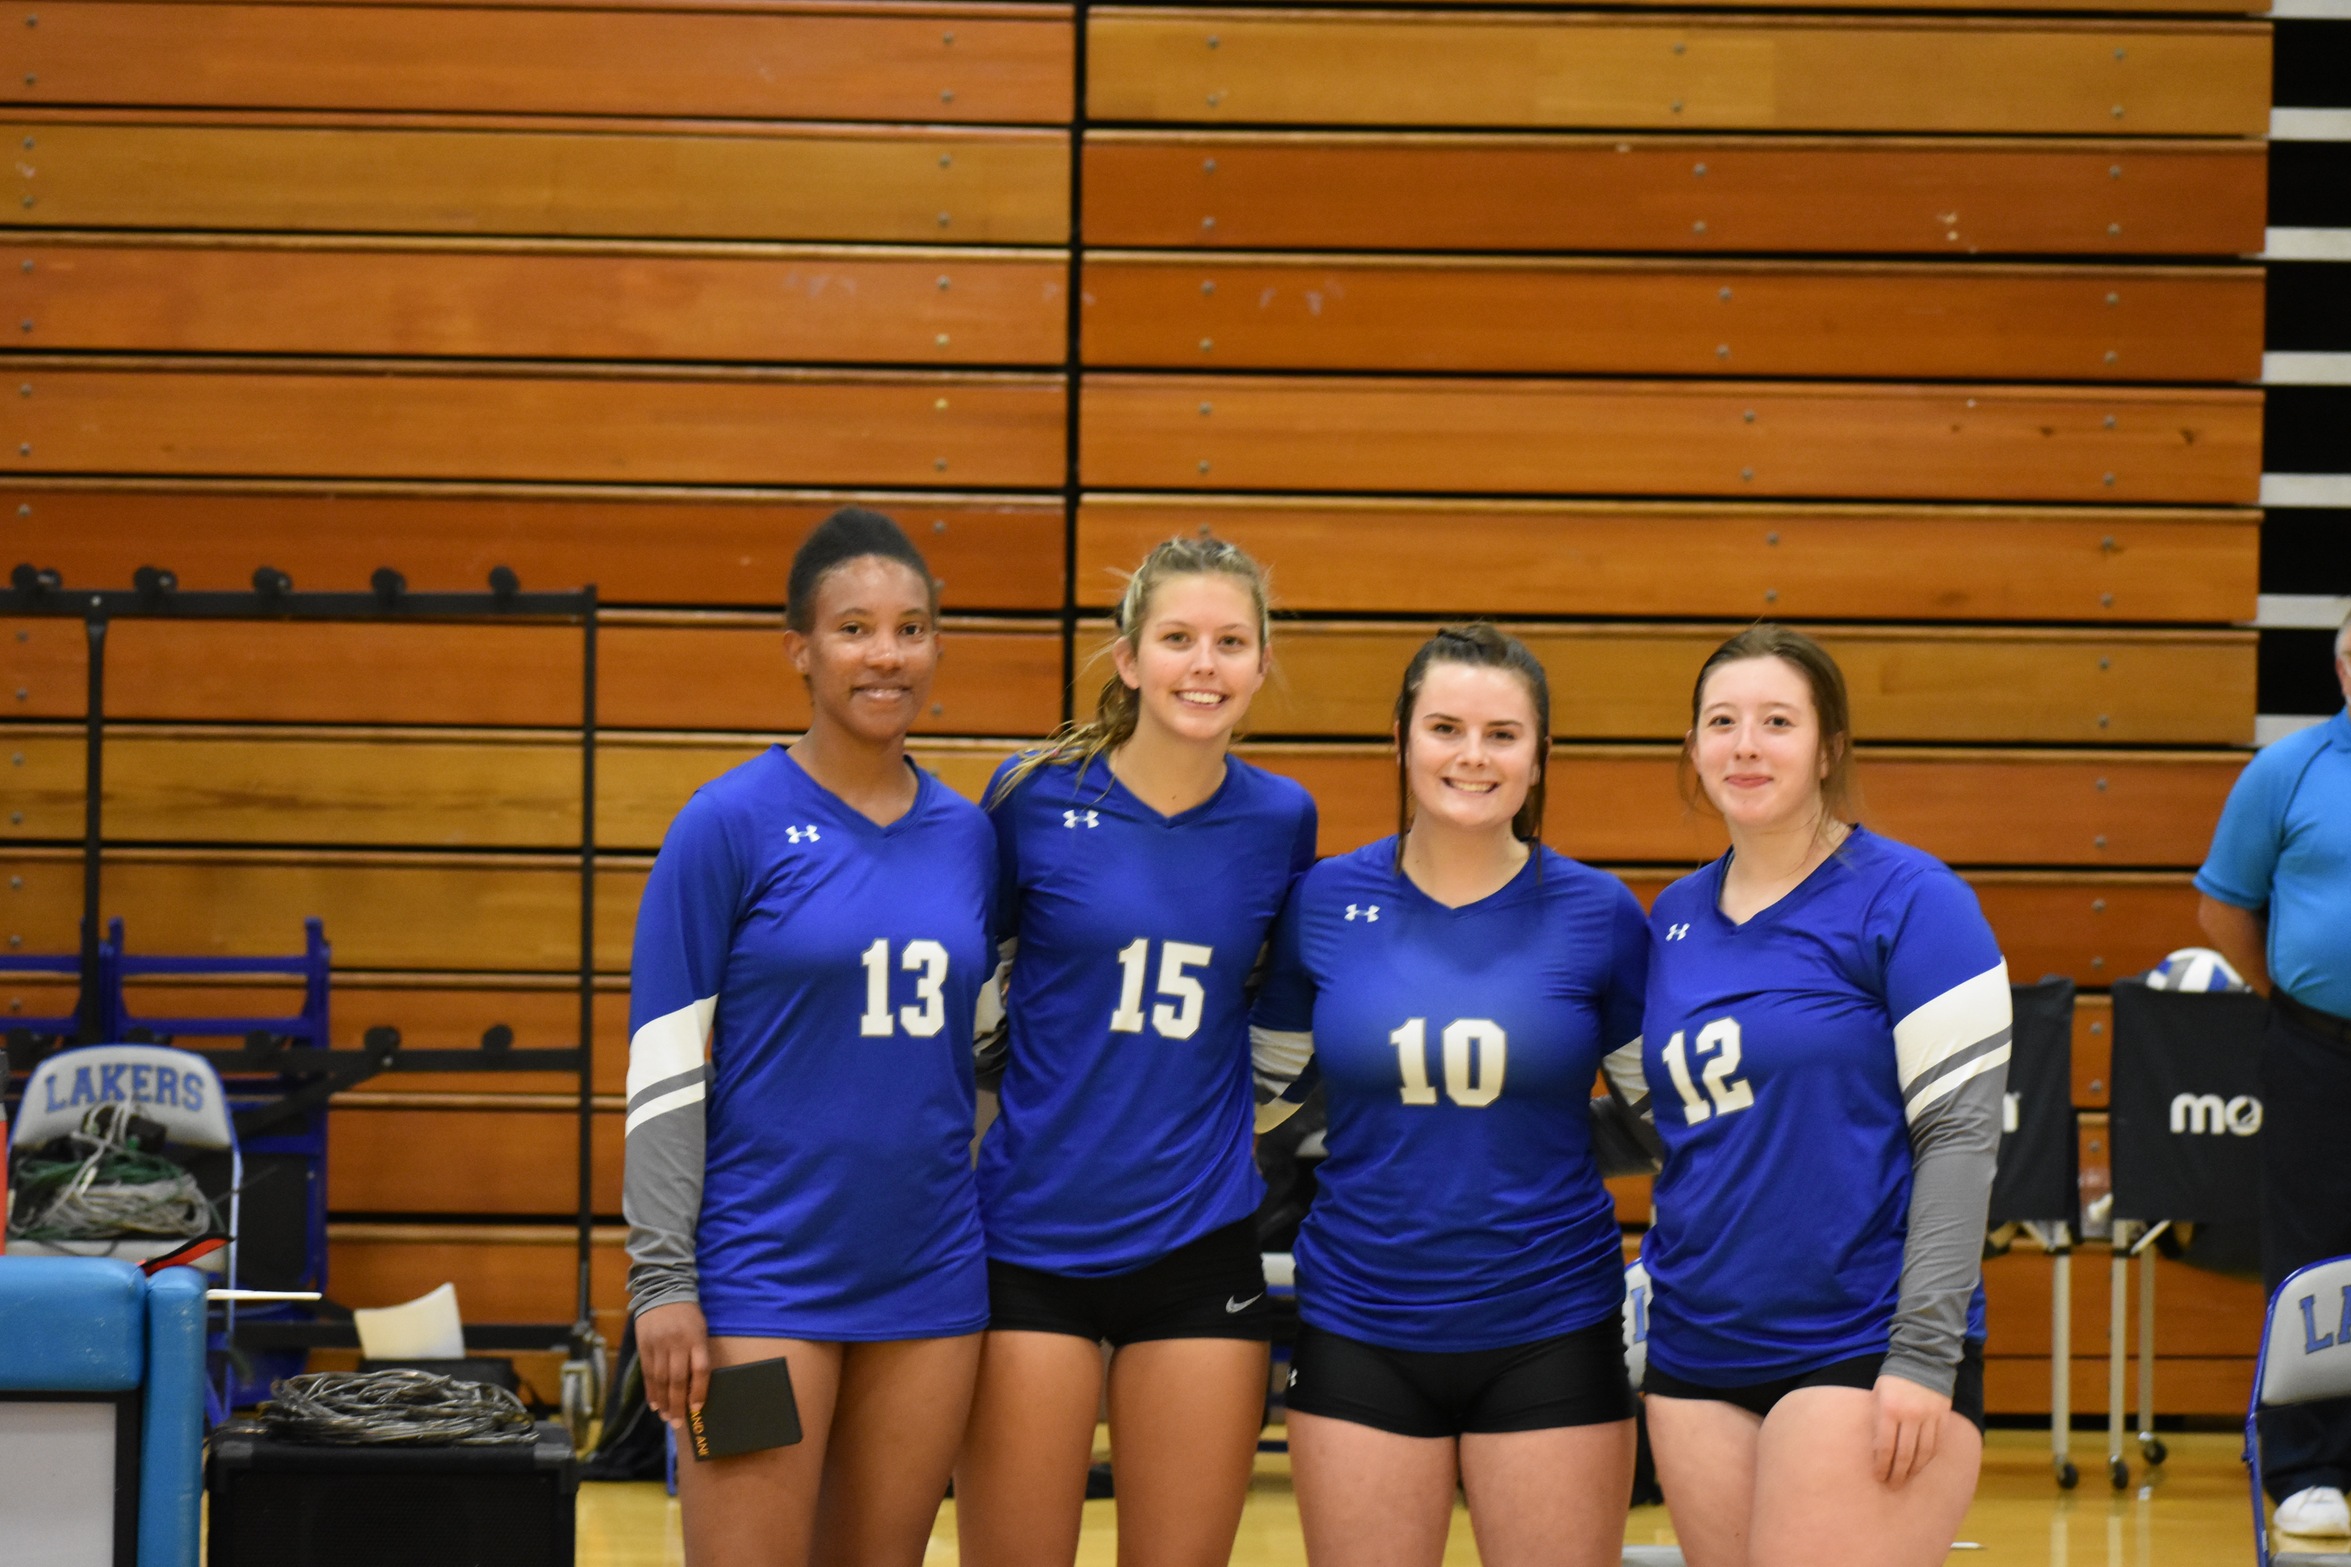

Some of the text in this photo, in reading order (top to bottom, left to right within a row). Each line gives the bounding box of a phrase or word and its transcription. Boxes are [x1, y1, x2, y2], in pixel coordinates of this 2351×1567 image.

[860, 937, 950, 1038] 13
[1109, 937, 1214, 1041] 15
[45, 1063, 205, 1113] LAKERS
[1389, 1016, 1508, 1108] 10
[1661, 1015, 1755, 1128] 12
